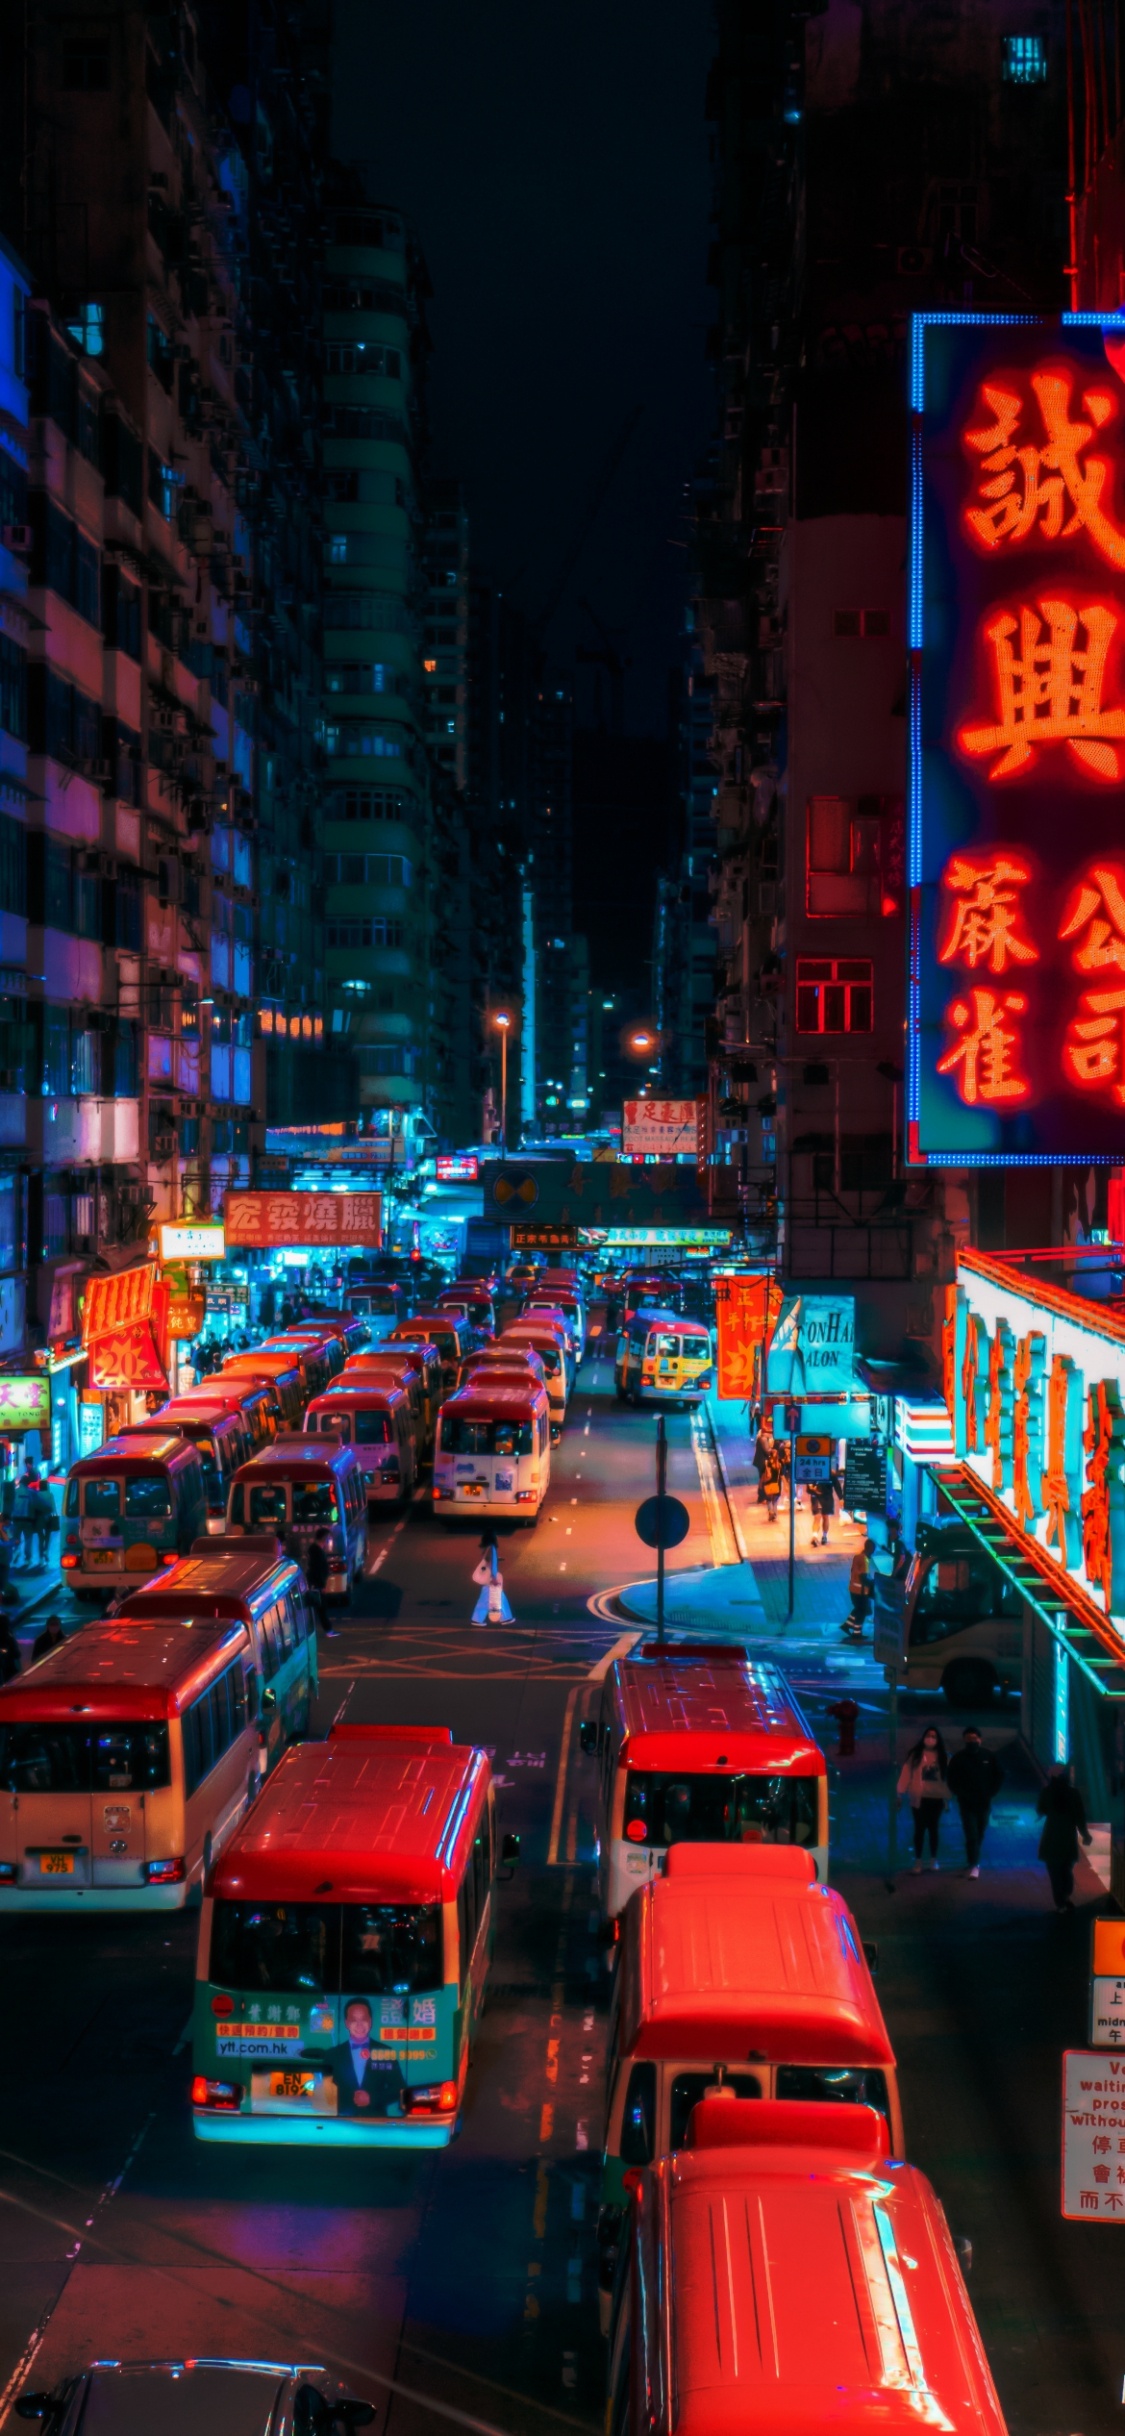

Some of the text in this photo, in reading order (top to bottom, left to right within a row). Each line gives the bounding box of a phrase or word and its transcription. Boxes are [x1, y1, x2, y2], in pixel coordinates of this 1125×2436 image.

[1058, 869, 1125, 1104] 公司
[103, 1352, 138, 1378] 20
[799, 1458, 826, 1466] 24 hrs
[50, 1854, 65, 1864] VH
[46, 1863, 68, 1873] 975
[1109, 1991, 1123, 2004] 上
[1108, 2029, 1122, 2042] 午
[220, 2041, 288, 2055] ytt.com.hk
[283, 2073, 302, 2085] EN
[1080, 2190, 1124, 2211] 而不
